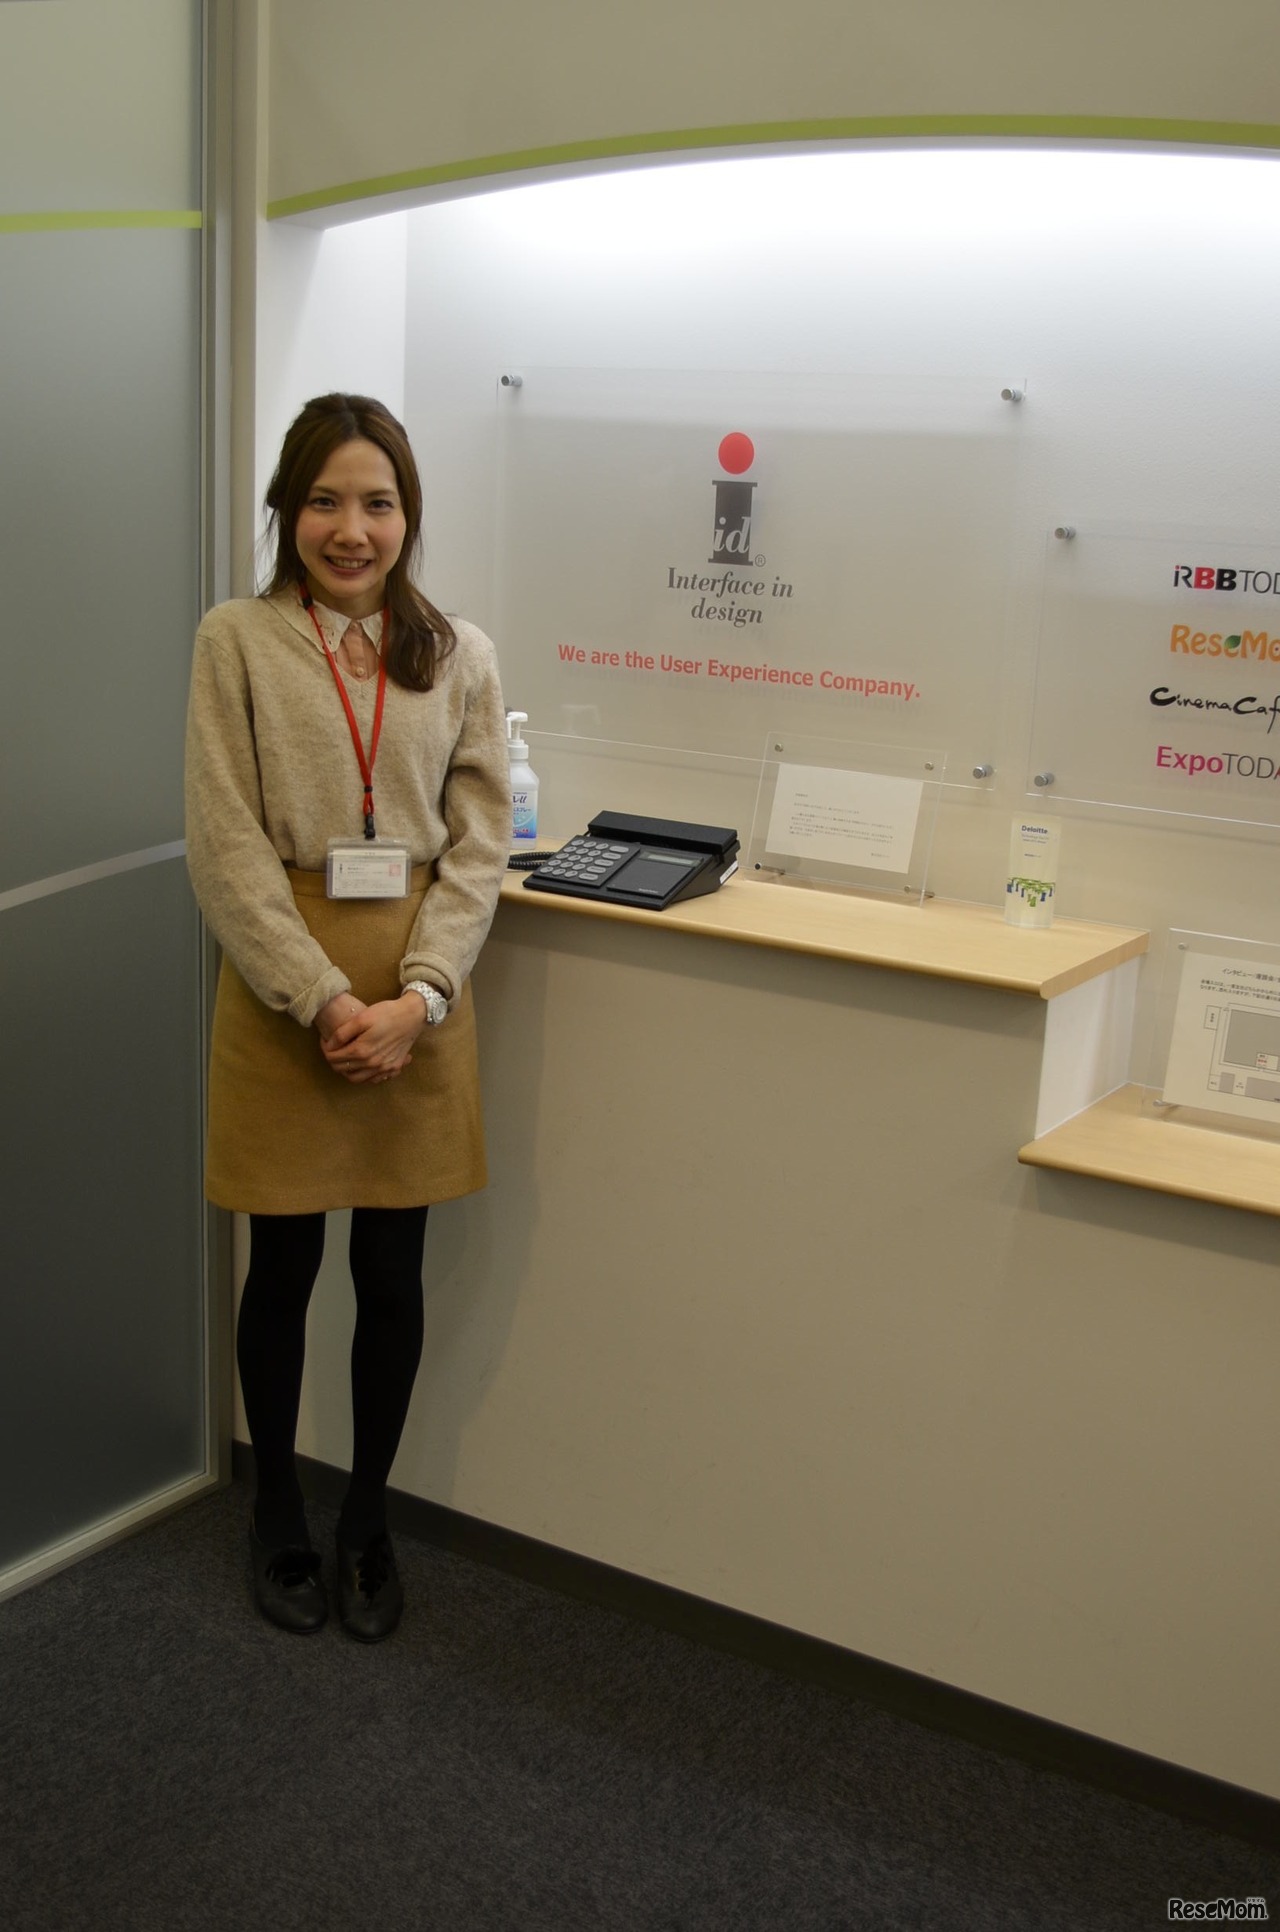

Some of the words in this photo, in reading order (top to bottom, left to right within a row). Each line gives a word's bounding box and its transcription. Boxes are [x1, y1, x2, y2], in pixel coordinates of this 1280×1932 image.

[667, 567, 766, 598] Interface
[771, 576, 793, 598] in
[691, 598, 763, 628] design
[558, 644, 586, 663] We
[590, 649, 620, 666] are
[624, 651, 655, 669] the
[660, 655, 702, 675] User
[707, 660, 814, 687] Experience
[819, 671, 920, 700] Company.
[1021, 825, 1048, 834] Deloitte
